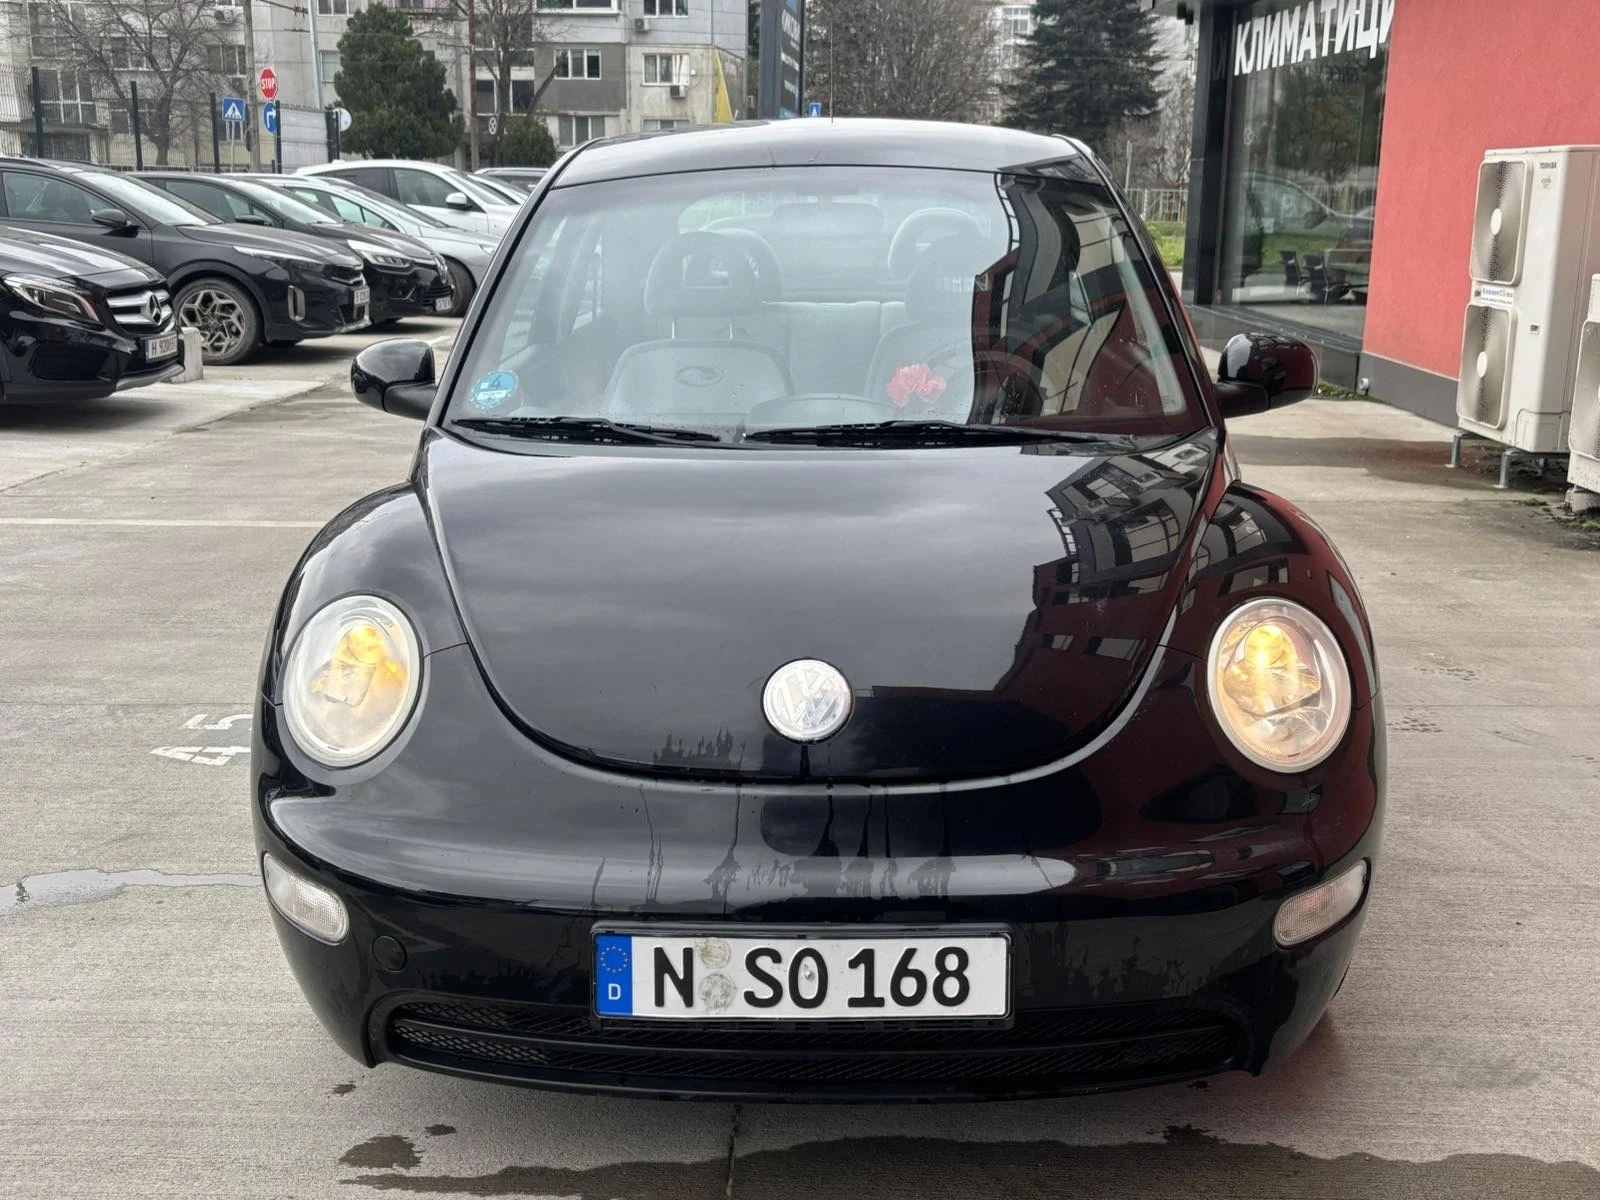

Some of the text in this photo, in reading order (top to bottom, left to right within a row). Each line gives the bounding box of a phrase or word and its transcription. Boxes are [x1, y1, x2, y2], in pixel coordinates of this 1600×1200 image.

[261, 77, 275, 90] STOP
[653, 946, 970, 1009] N SO 168
[608, 983, 621, 1000] D
